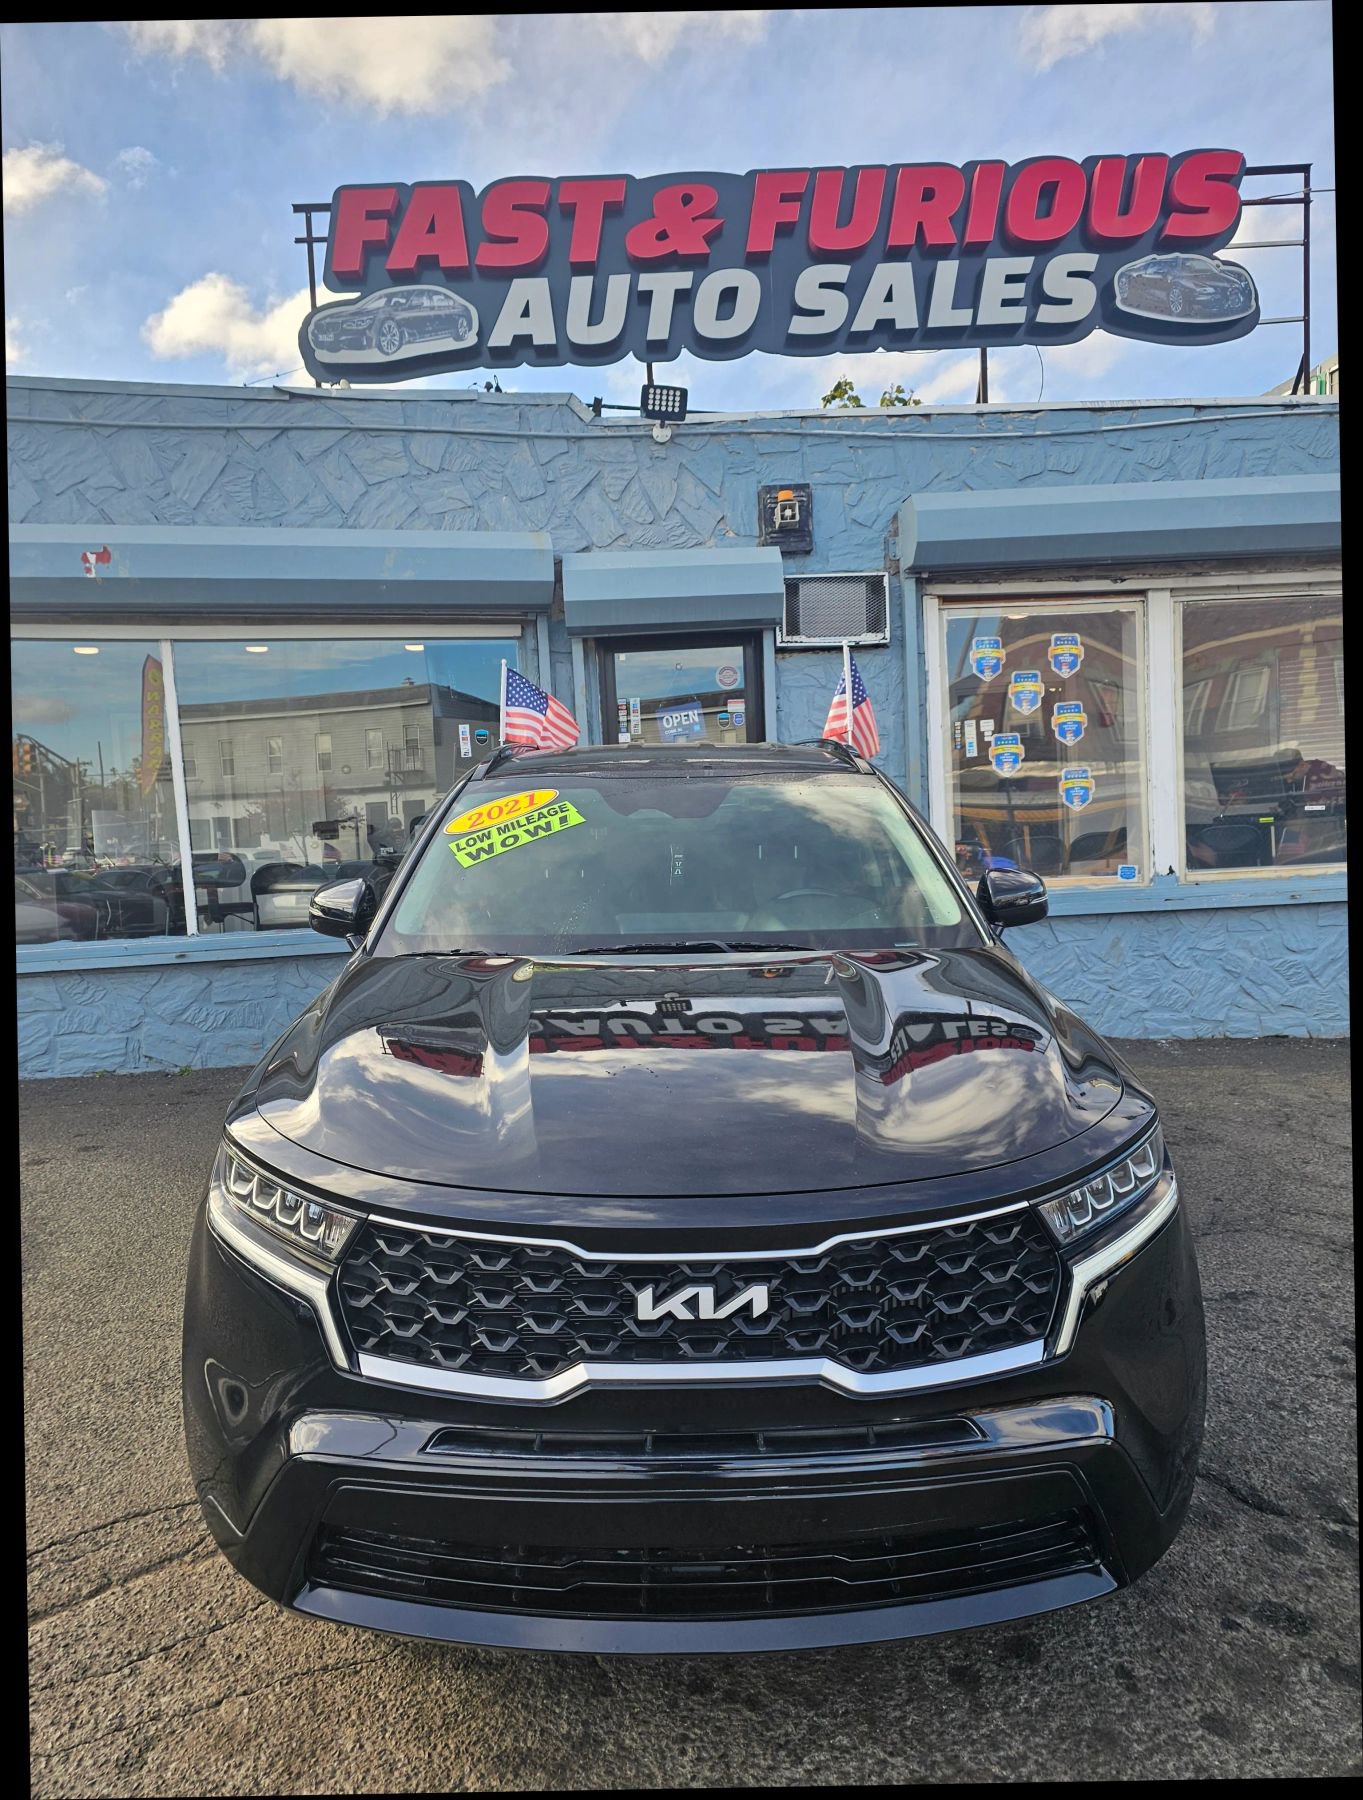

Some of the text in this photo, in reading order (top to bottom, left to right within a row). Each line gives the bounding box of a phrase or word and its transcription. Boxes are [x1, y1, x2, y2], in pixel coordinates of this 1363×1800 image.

[332, 150, 1245, 278] FAST & FURIOUS
[486, 252, 1100, 350] AUTO SALES
[662, 709, 699, 728] OPEN
[455, 803, 570, 852] LOW MILEAGE
[467, 793, 539, 829] 2021
[465, 814, 570, 862] WOW!
[637, 1284, 769, 1320] KIA
